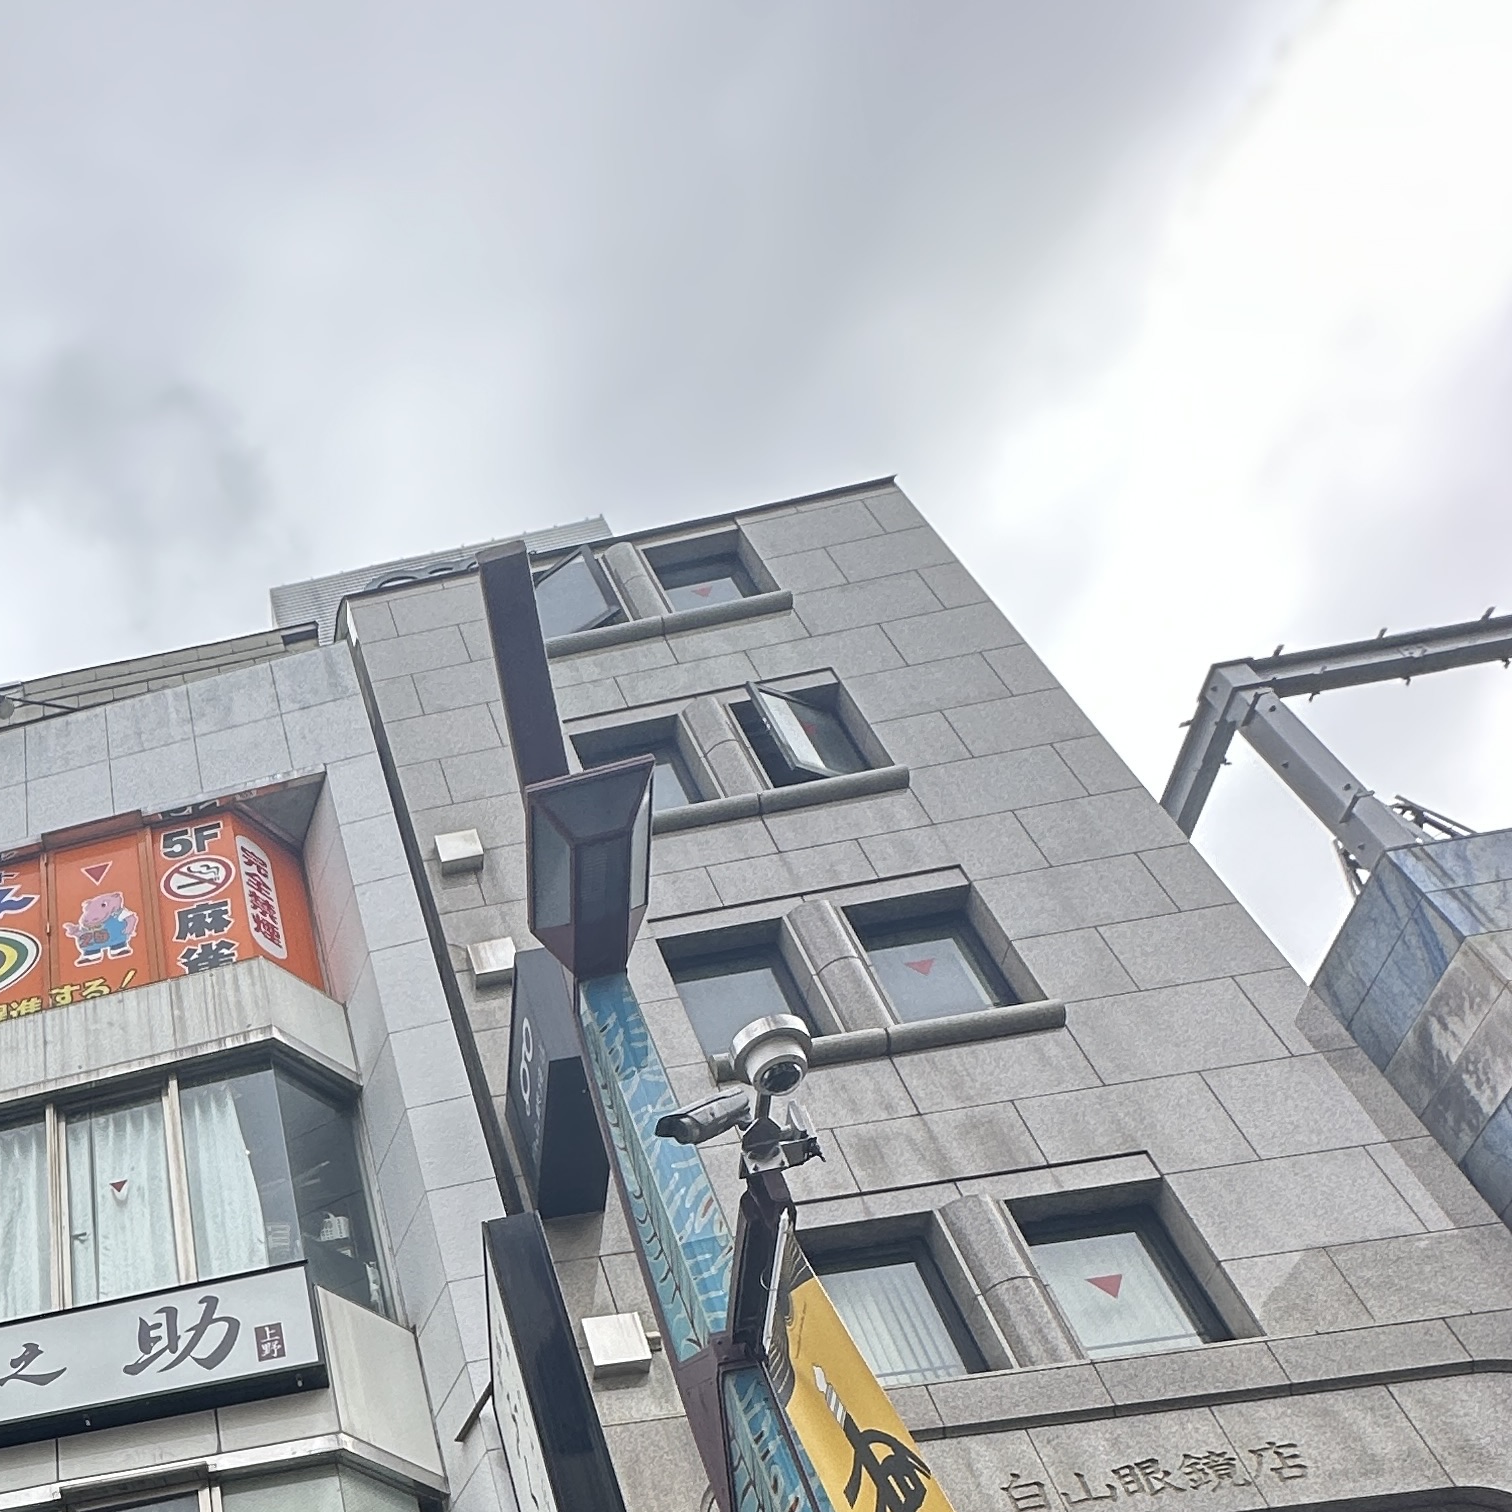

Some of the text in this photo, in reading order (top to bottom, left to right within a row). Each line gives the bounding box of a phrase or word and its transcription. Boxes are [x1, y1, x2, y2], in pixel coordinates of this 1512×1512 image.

[161, 821, 223, 861] 5F
[240, 846, 283, 949] 完全禁煙
[258, 1324, 284, 1359] 上野
